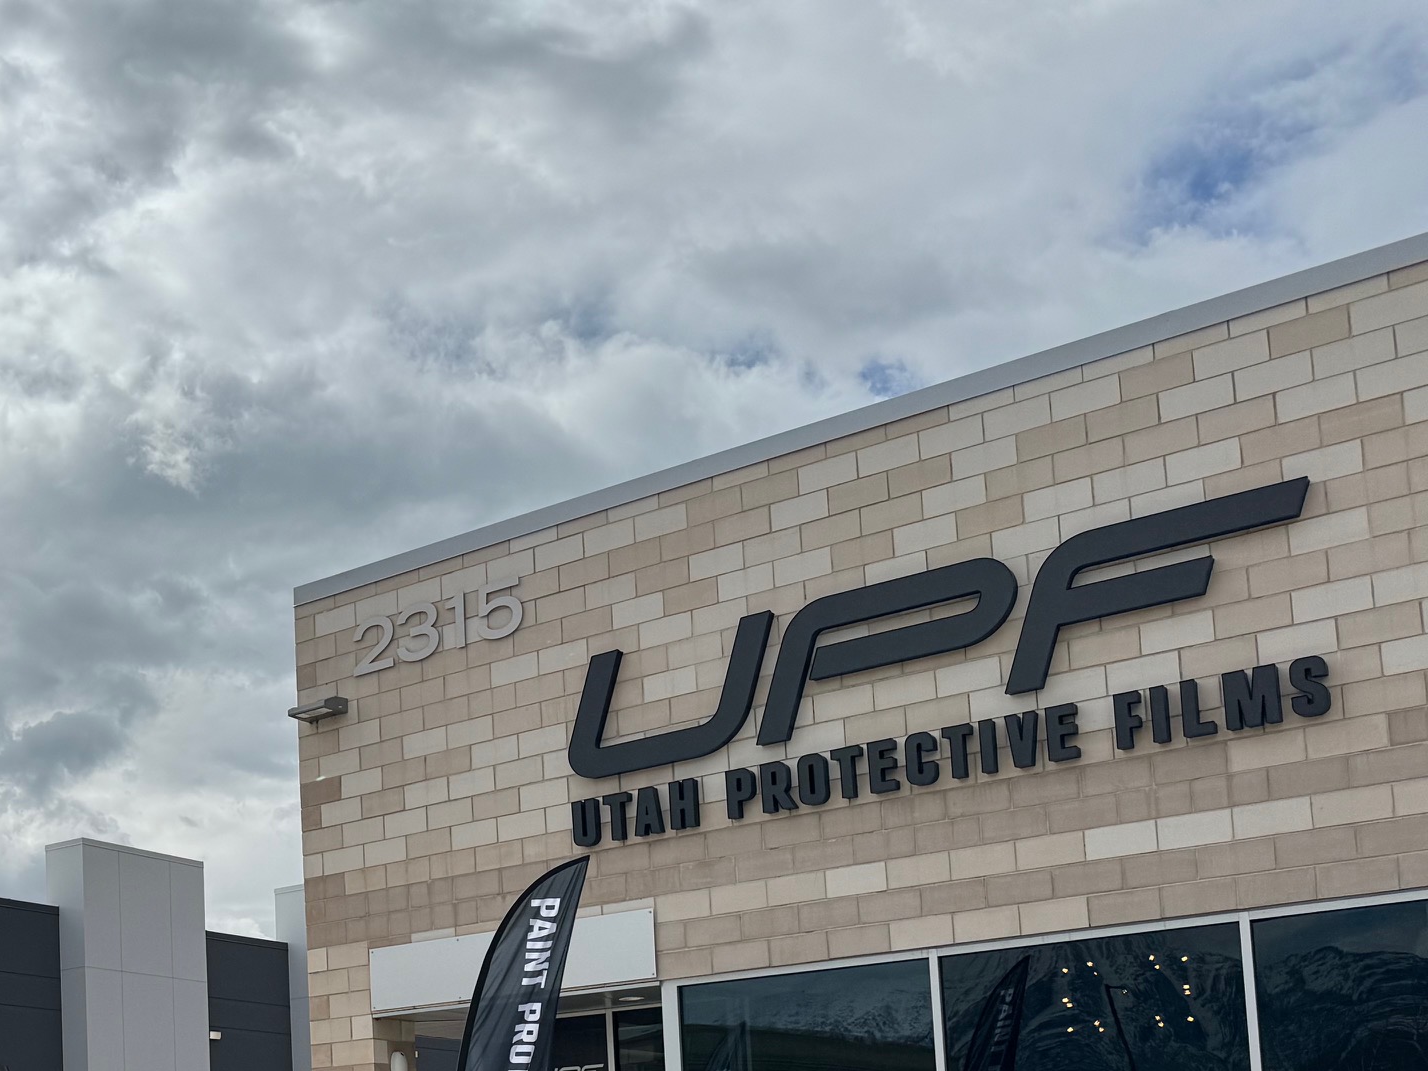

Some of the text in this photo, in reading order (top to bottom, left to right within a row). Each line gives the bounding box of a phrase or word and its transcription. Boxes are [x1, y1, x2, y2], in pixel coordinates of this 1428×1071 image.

[352, 575, 524, 678] 2315
[567, 475, 1311, 780] UPF
[571, 655, 1332, 848] UTAH PROTECTIVE FILMS
[521, 897, 561, 989] PAINT
